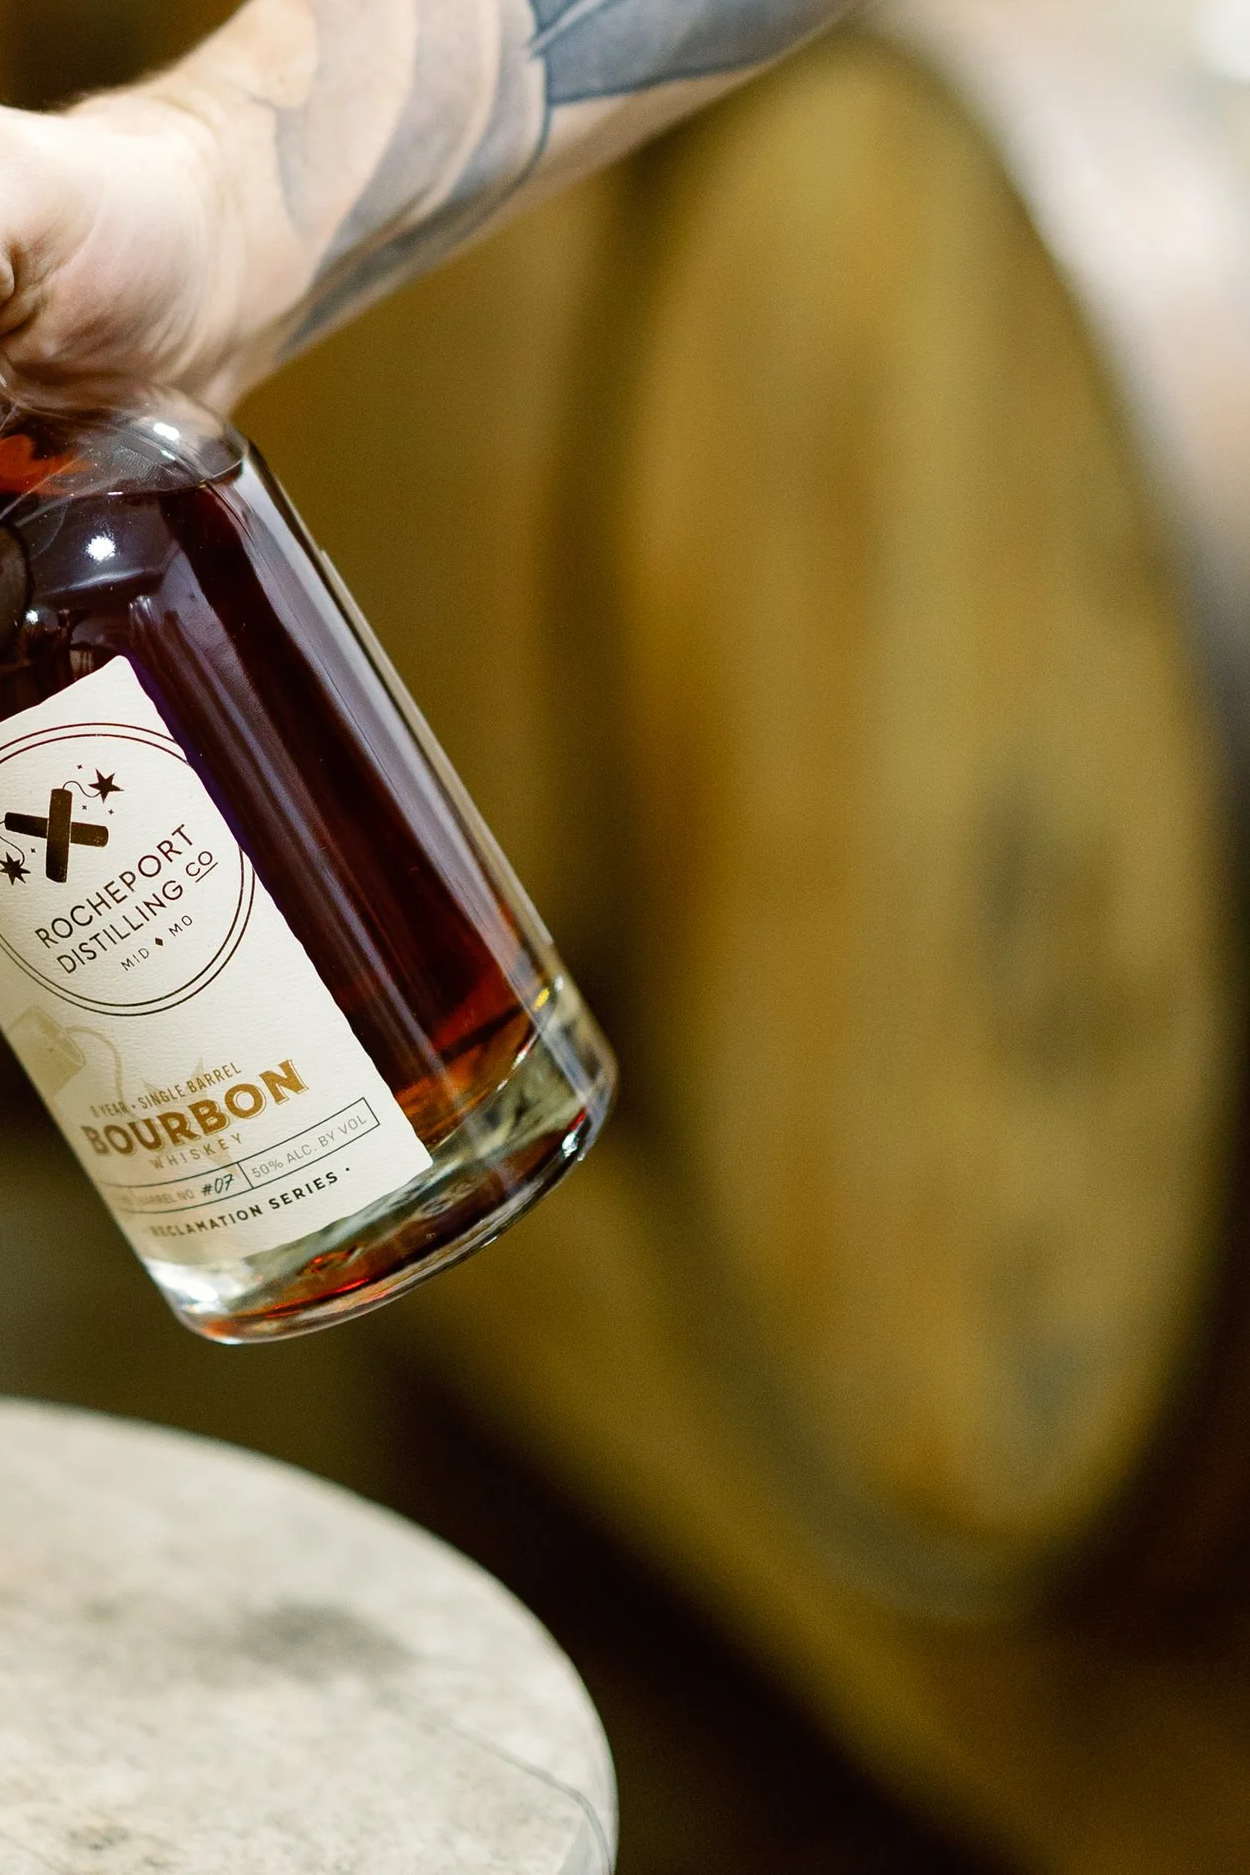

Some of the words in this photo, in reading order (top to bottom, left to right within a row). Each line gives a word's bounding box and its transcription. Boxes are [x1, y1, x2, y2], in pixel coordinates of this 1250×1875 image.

[34, 824, 193, 949] ROCHEPORT
[56, 880, 183, 974] DISTILLING
[185, 851, 215, 879] CO
[120, 947, 149, 972] MID
[168, 914, 193, 937] MO
[80, 1059, 309, 1157] BOURBON
[100, 1101, 131, 1117] YEAR
[137, 1084, 188, 1110] SINGLE
[186, 1062, 242, 1094] BARREL
[150, 1133, 243, 1171] WHISKEY
[252, 1157, 284, 1179] 50%
[287, 1144, 318, 1164] ALC.
[318, 1130, 337, 1148] BY
[338, 1115, 367, 1136] VOL
[149, 1204, 264, 1238] RECLAMATION
[268, 1171, 338, 1210] SERIES
[200, 1173, 235, 1195] #07
